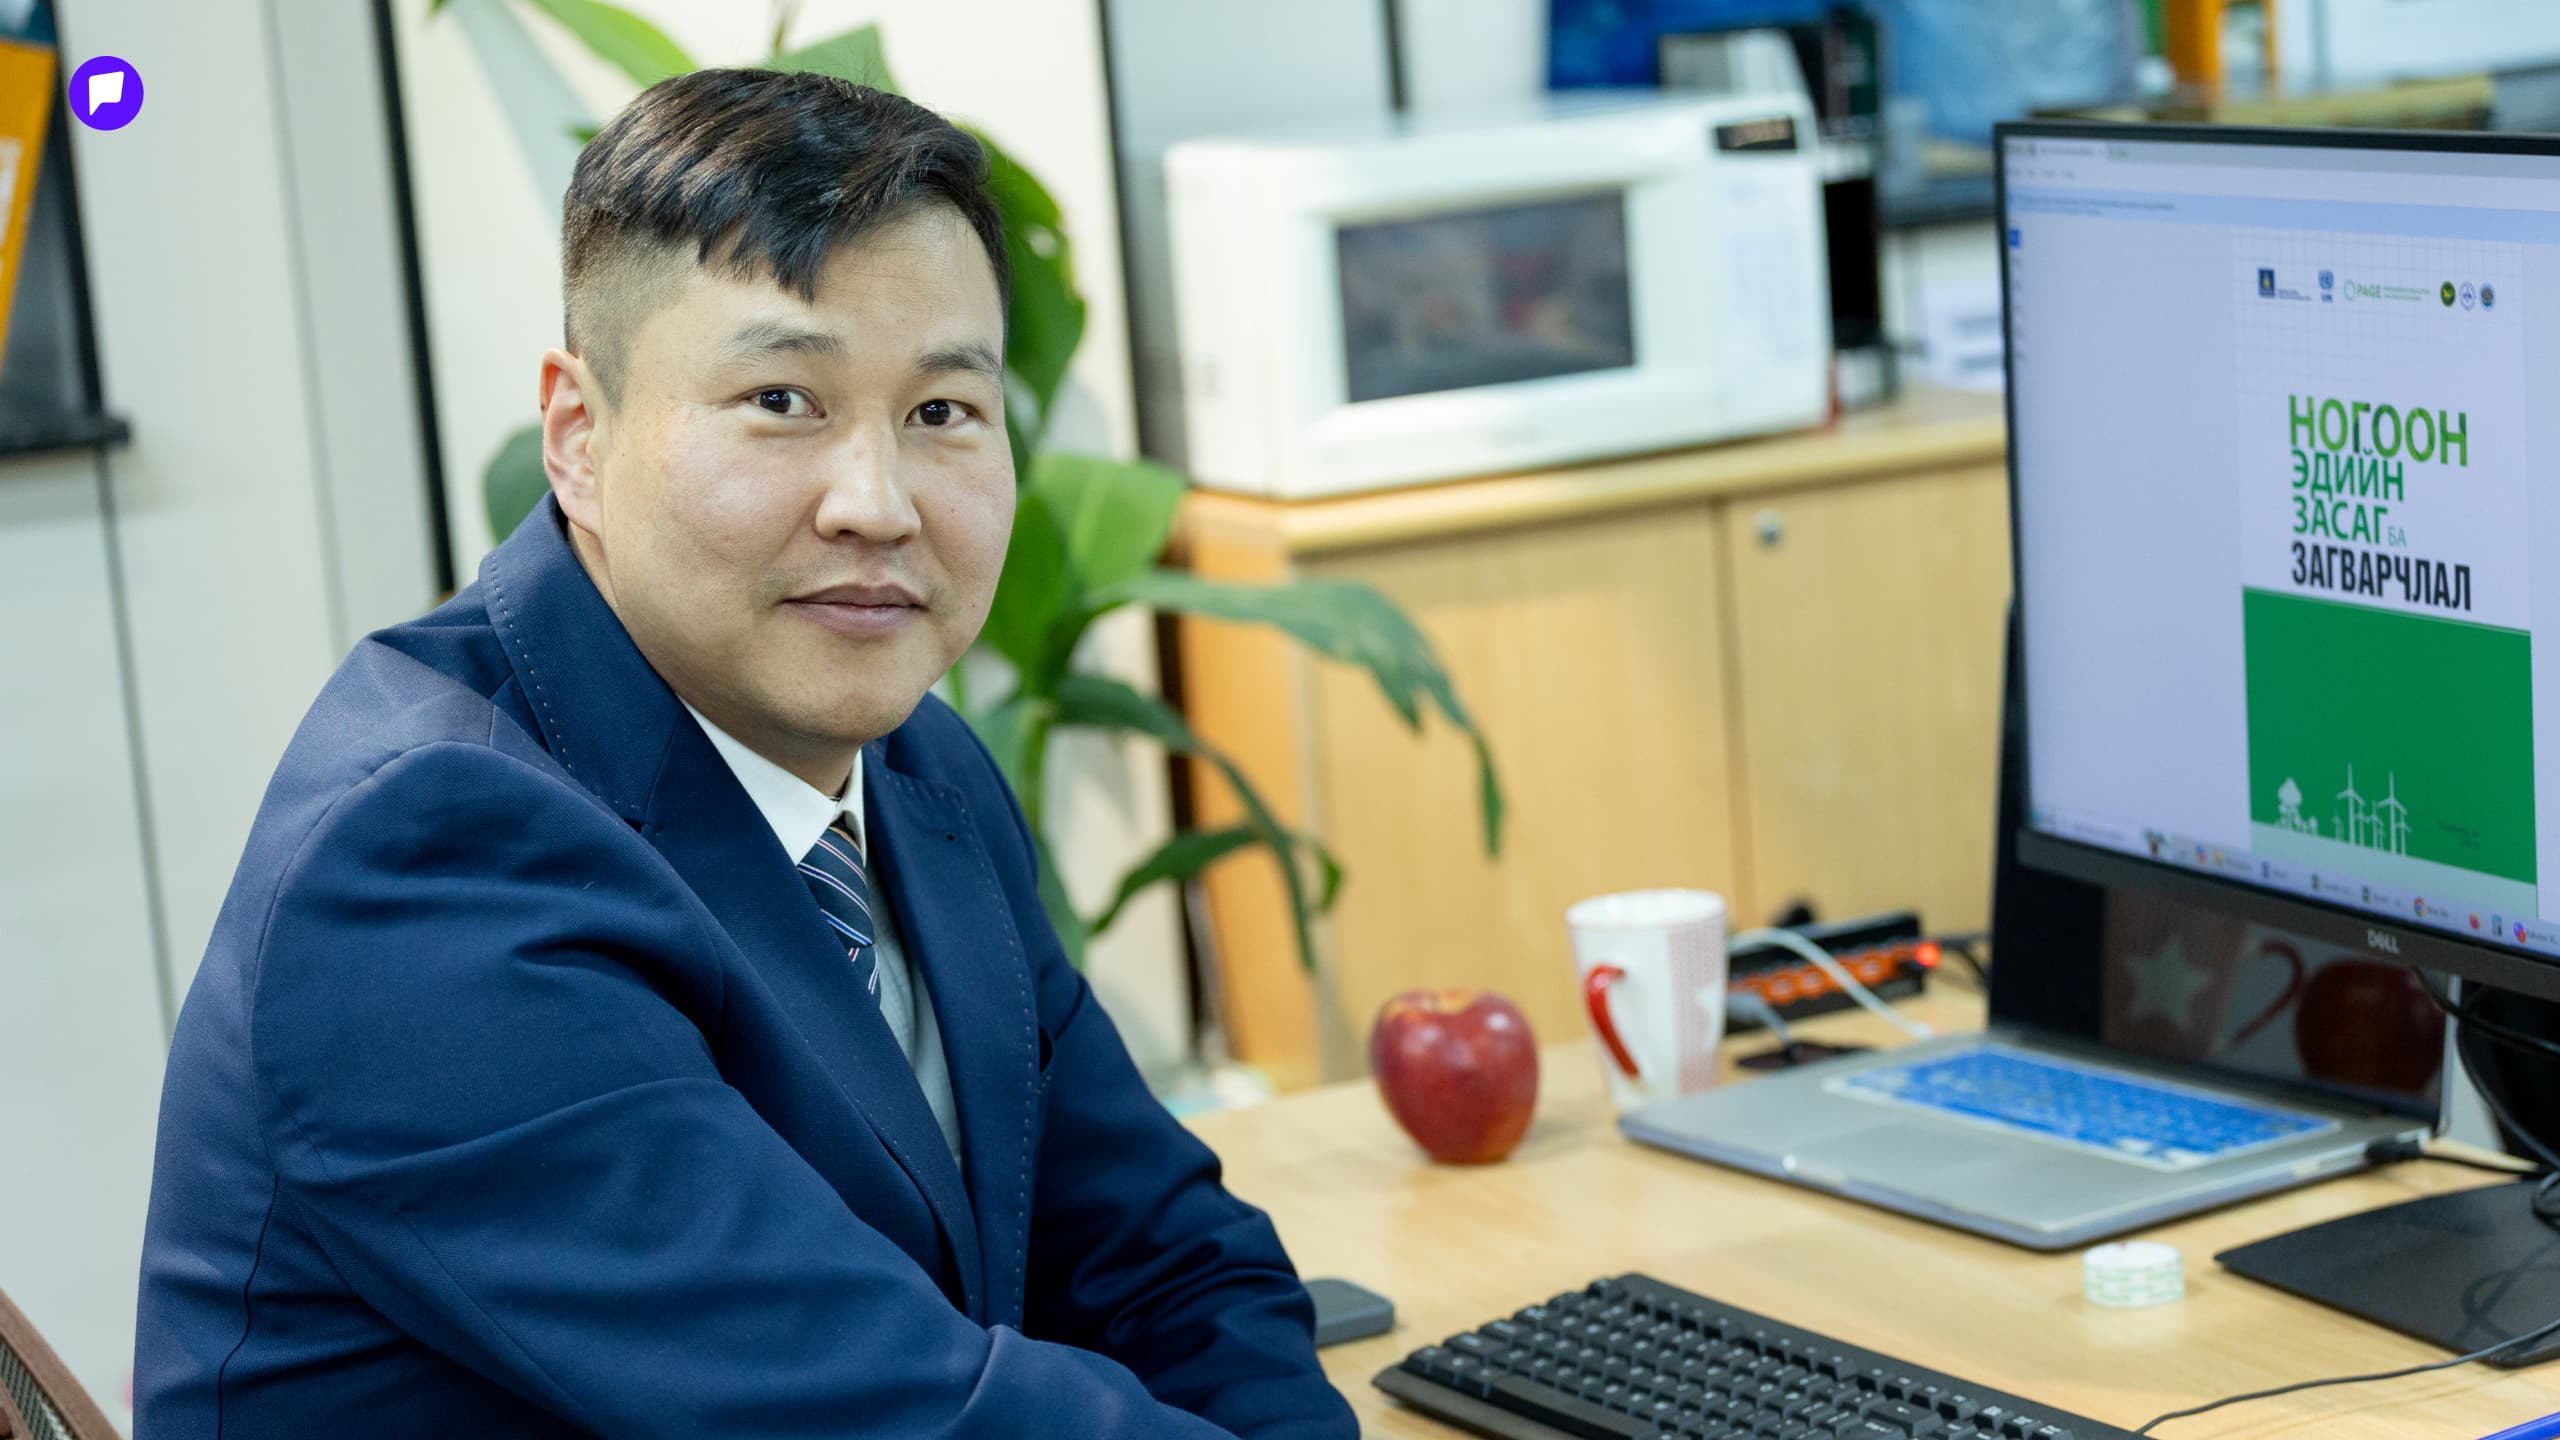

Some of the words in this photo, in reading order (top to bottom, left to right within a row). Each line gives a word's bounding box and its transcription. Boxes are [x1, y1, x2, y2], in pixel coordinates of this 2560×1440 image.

[2357, 283, 2381, 298] PAGE
[2289, 394, 2468, 467] НОГООН
[2291, 448, 2404, 502] ЭДИЙН
[2293, 496, 2388, 544] ЗАСАГ
[2388, 526, 2407, 547] БА
[2292, 541, 2471, 611] ЗАГВАРЧЛАЛ
[2367, 929, 2400, 954] DELL
